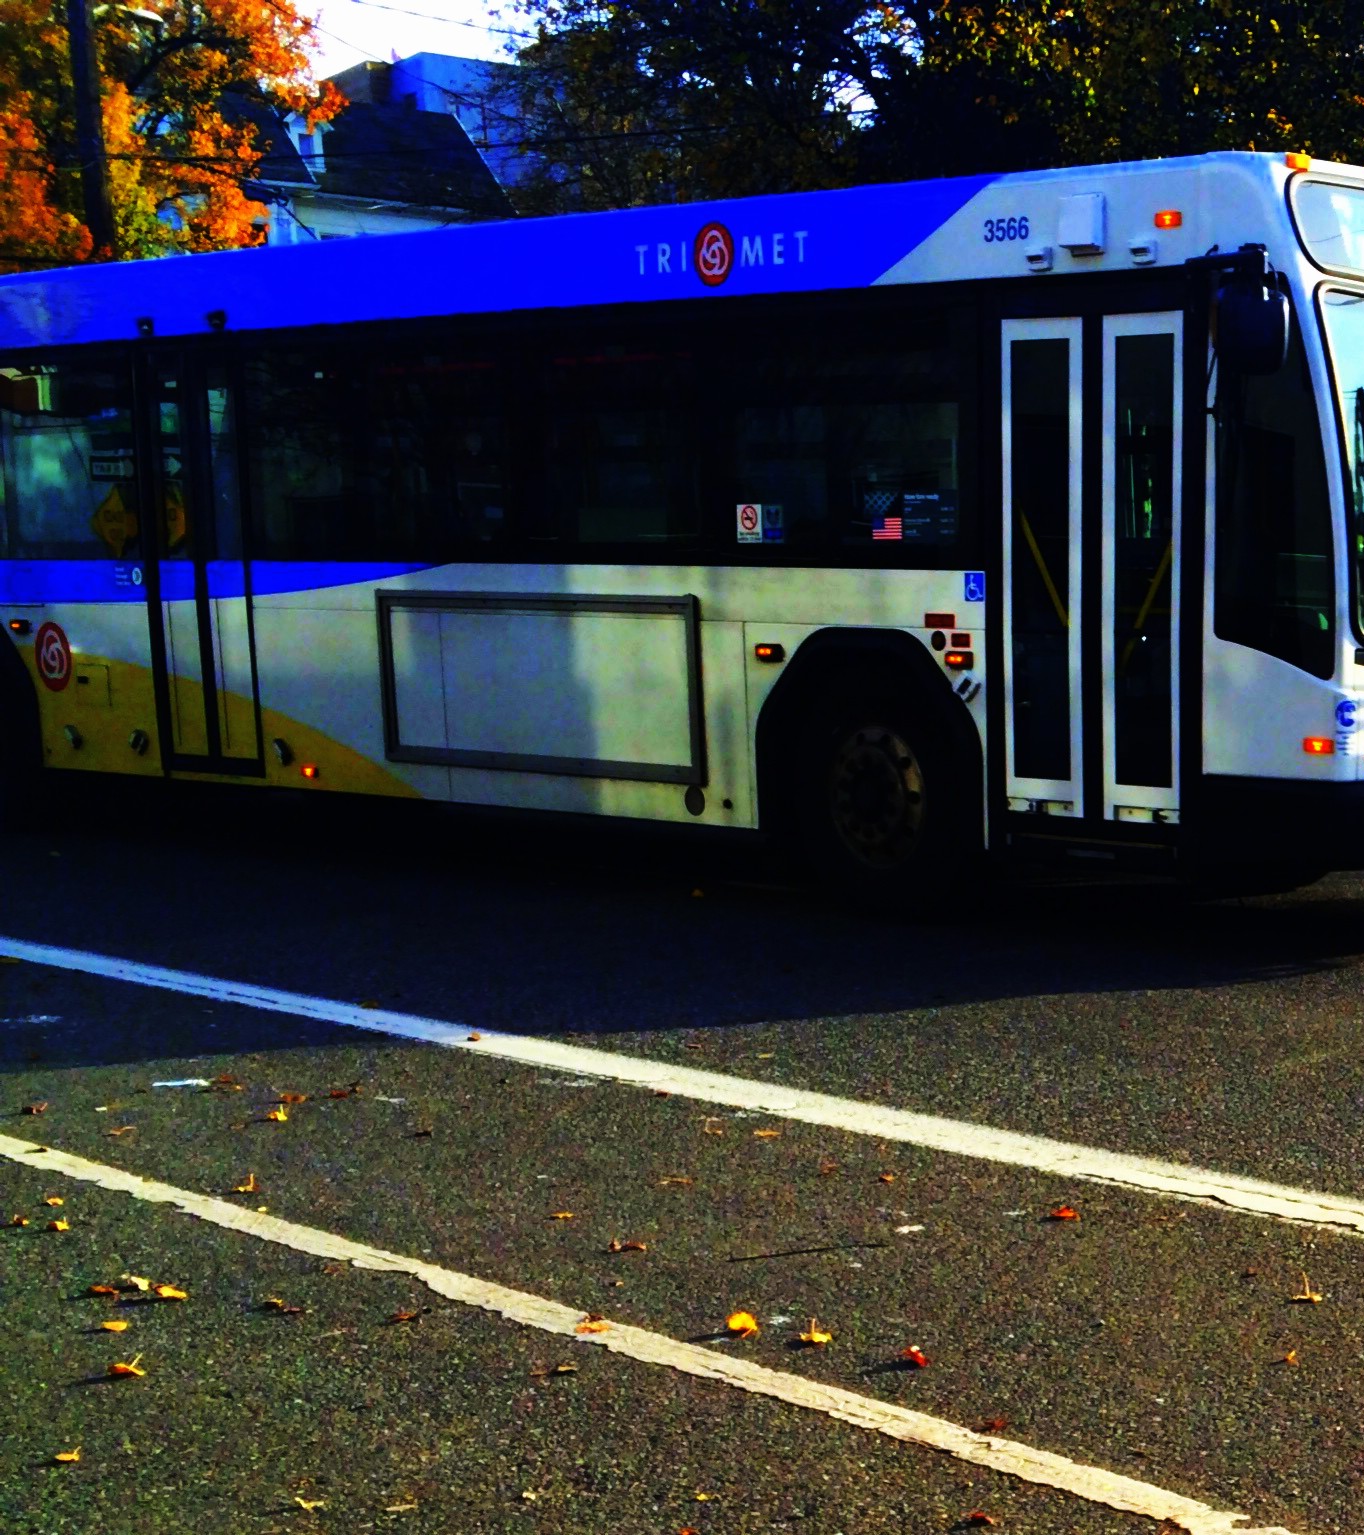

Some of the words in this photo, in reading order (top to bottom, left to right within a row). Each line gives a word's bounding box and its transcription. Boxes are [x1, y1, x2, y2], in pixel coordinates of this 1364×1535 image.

[983, 215, 1030, 243] 3566
[635, 240, 687, 276] TRI
[740, 230, 809, 268] MET
